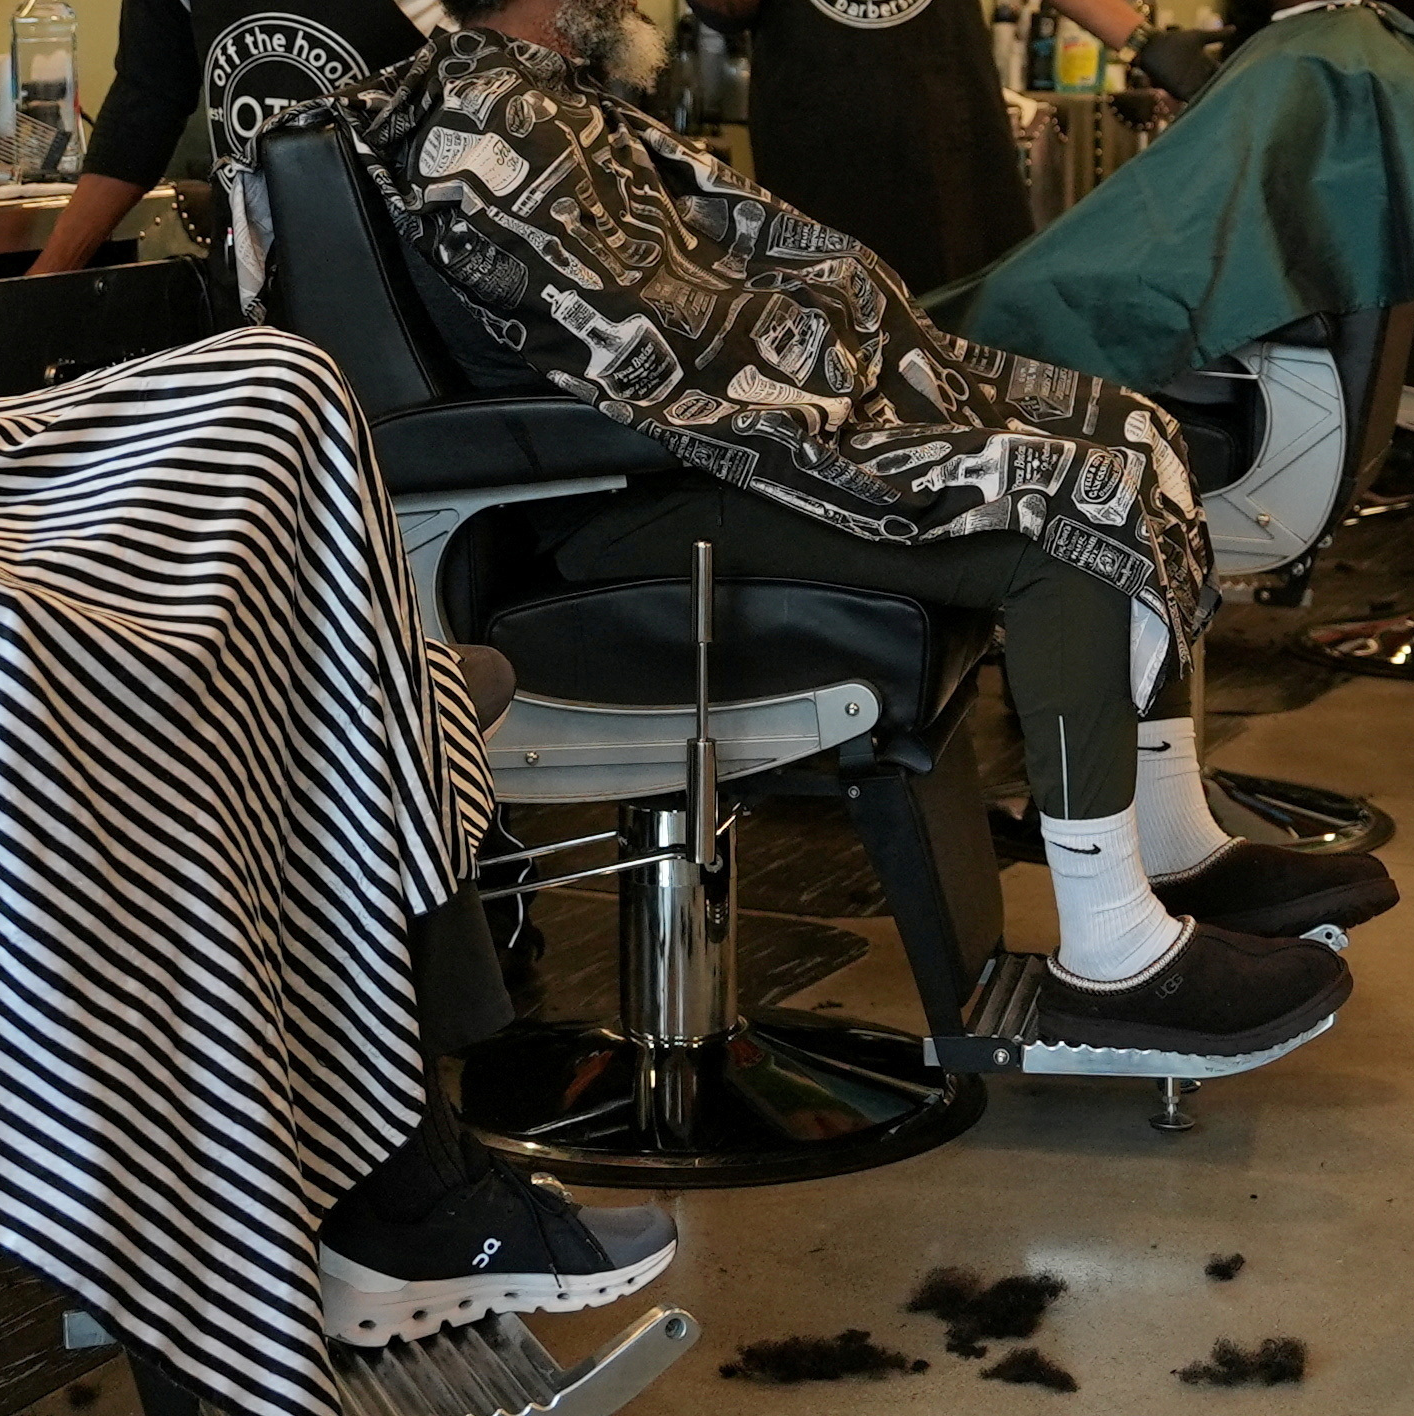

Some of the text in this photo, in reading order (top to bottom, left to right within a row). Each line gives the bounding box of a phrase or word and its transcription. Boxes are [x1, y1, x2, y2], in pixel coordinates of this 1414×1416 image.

[213, 26, 360, 88] off the hook
[1154, 973, 1184, 999] UGG
